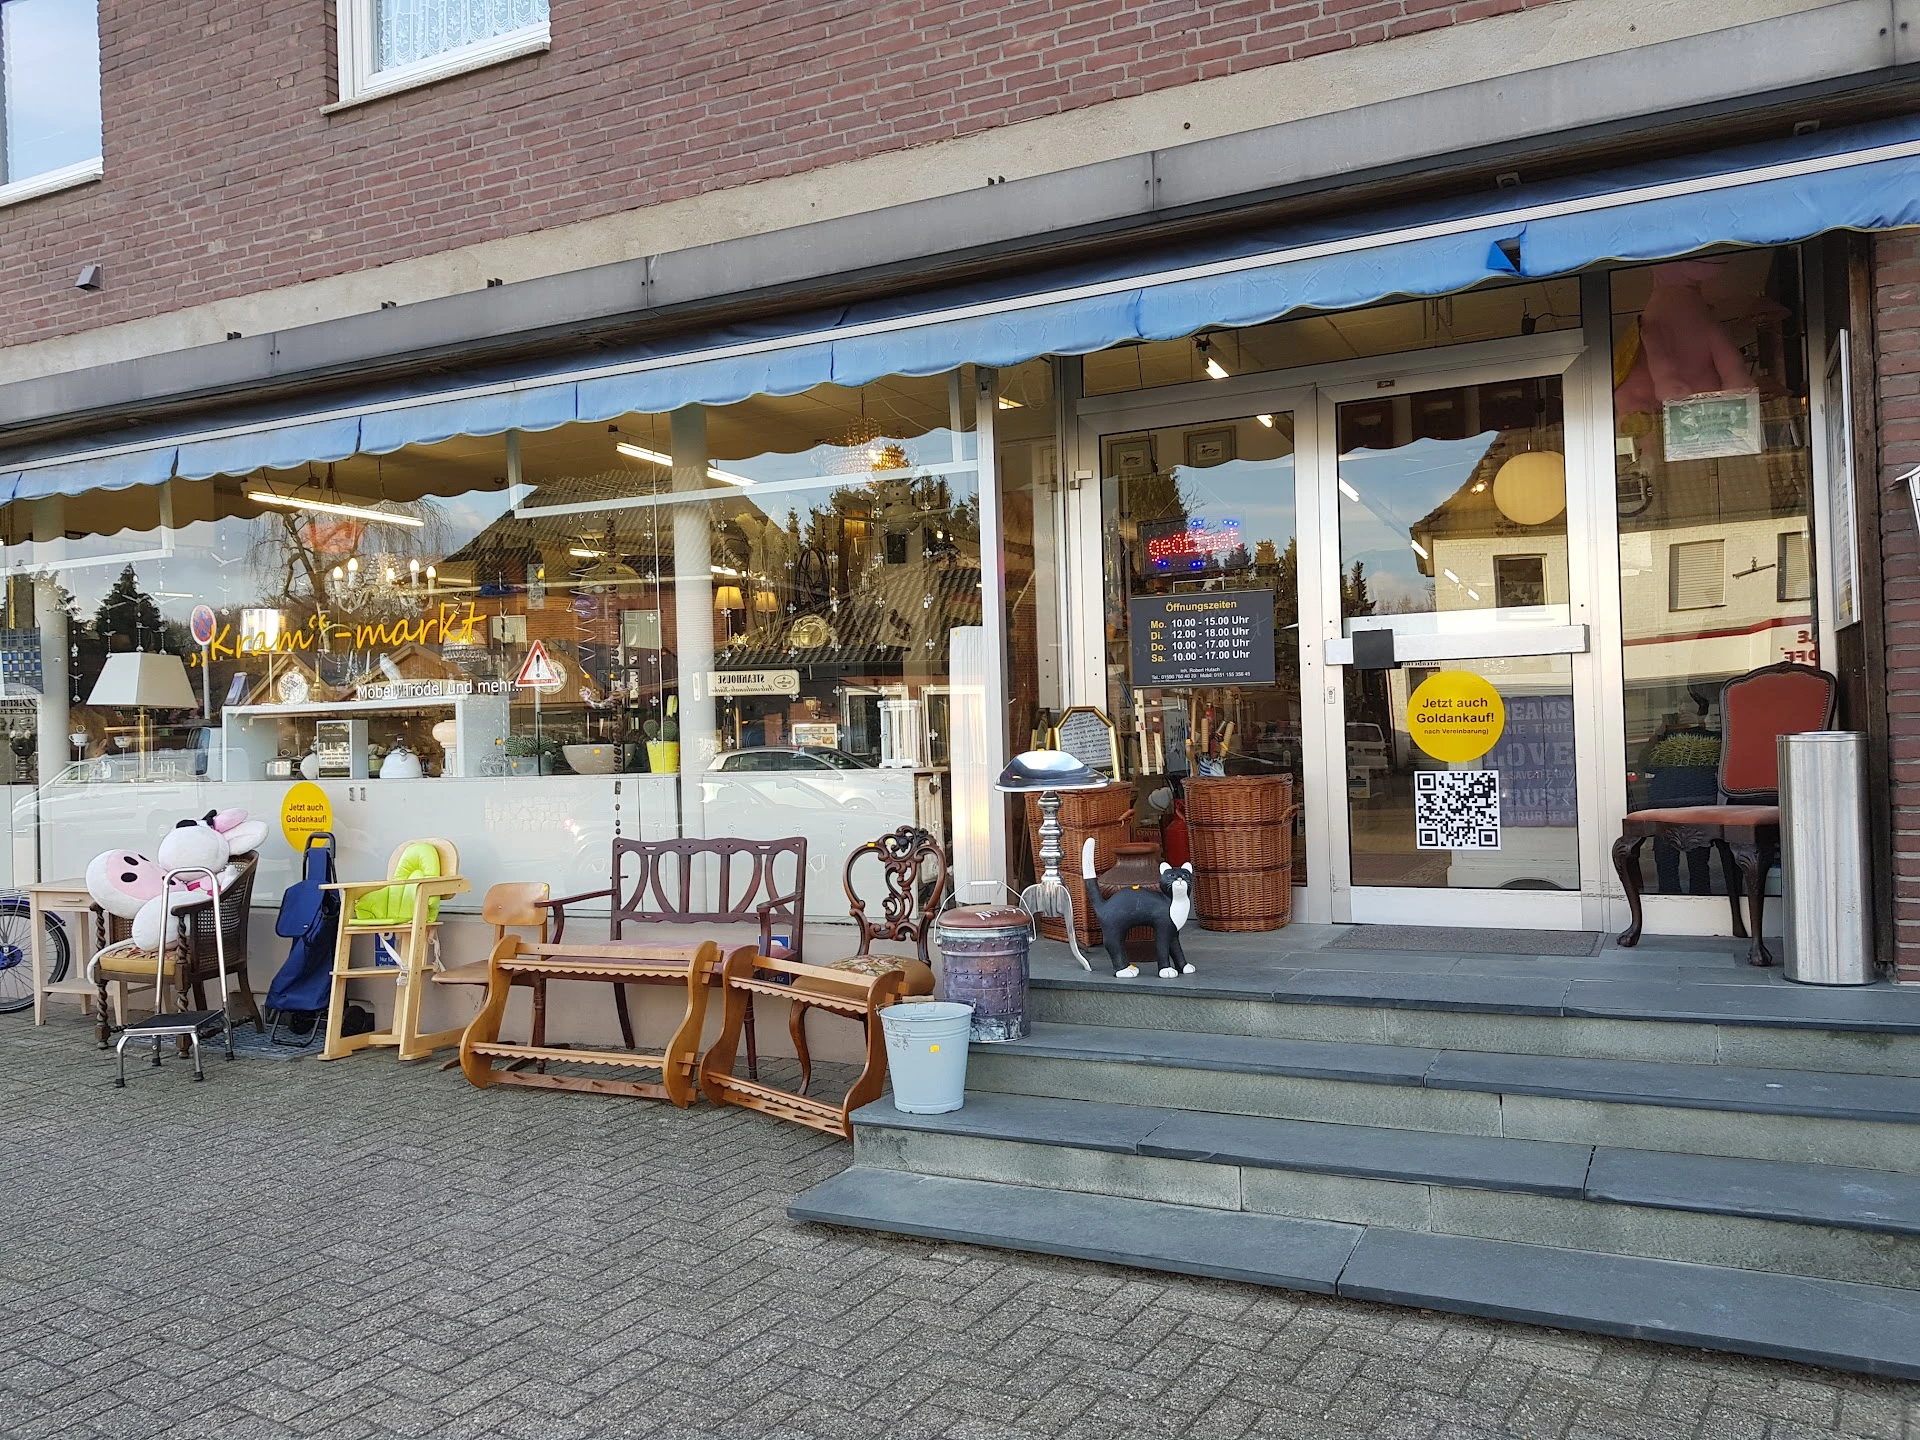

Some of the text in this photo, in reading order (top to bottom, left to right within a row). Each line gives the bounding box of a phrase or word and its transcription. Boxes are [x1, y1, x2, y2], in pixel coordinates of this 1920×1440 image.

[1166, 600, 1237, 612] Öffnungszeiten
[1150, 620, 1167, 629] Mo.
[1172, 618, 1196, 628] 10.00
[1204, 616, 1229, 626] 15.00
[1231, 615, 1250, 625] Uhr
[1150, 631, 1163, 640] Di.
[1172, 630, 1196, 639] 12.00
[1204, 628, 1229, 637] 18.00
[1232, 626, 1250, 636] Uhr
[1151, 642, 1167, 651] Do.
[1172, 641, 1196, 650] 10.00
[1204, 639, 1230, 649] 17.00
[1232, 638, 1250, 648] Uhr
[1151, 653, 1166, 662] Sa.
[1172, 652, 1197, 661] 10.00
[1205, 650, 1230, 660] 17.00
[1232, 649, 1251, 659] Uhr
[403, 681, 443, 697] Trödel
[447, 679, 473, 695] und
[1422, 697, 1488, 708] Jetzt auch
[1505, 701, 1571, 721] EAMS
[1416, 712, 1495, 723] Goldankauf!
[1532, 722, 1572, 734] TRUE
[289, 803, 324, 811] Jetzt auch
[286, 814, 327, 823] Goldankauf!
